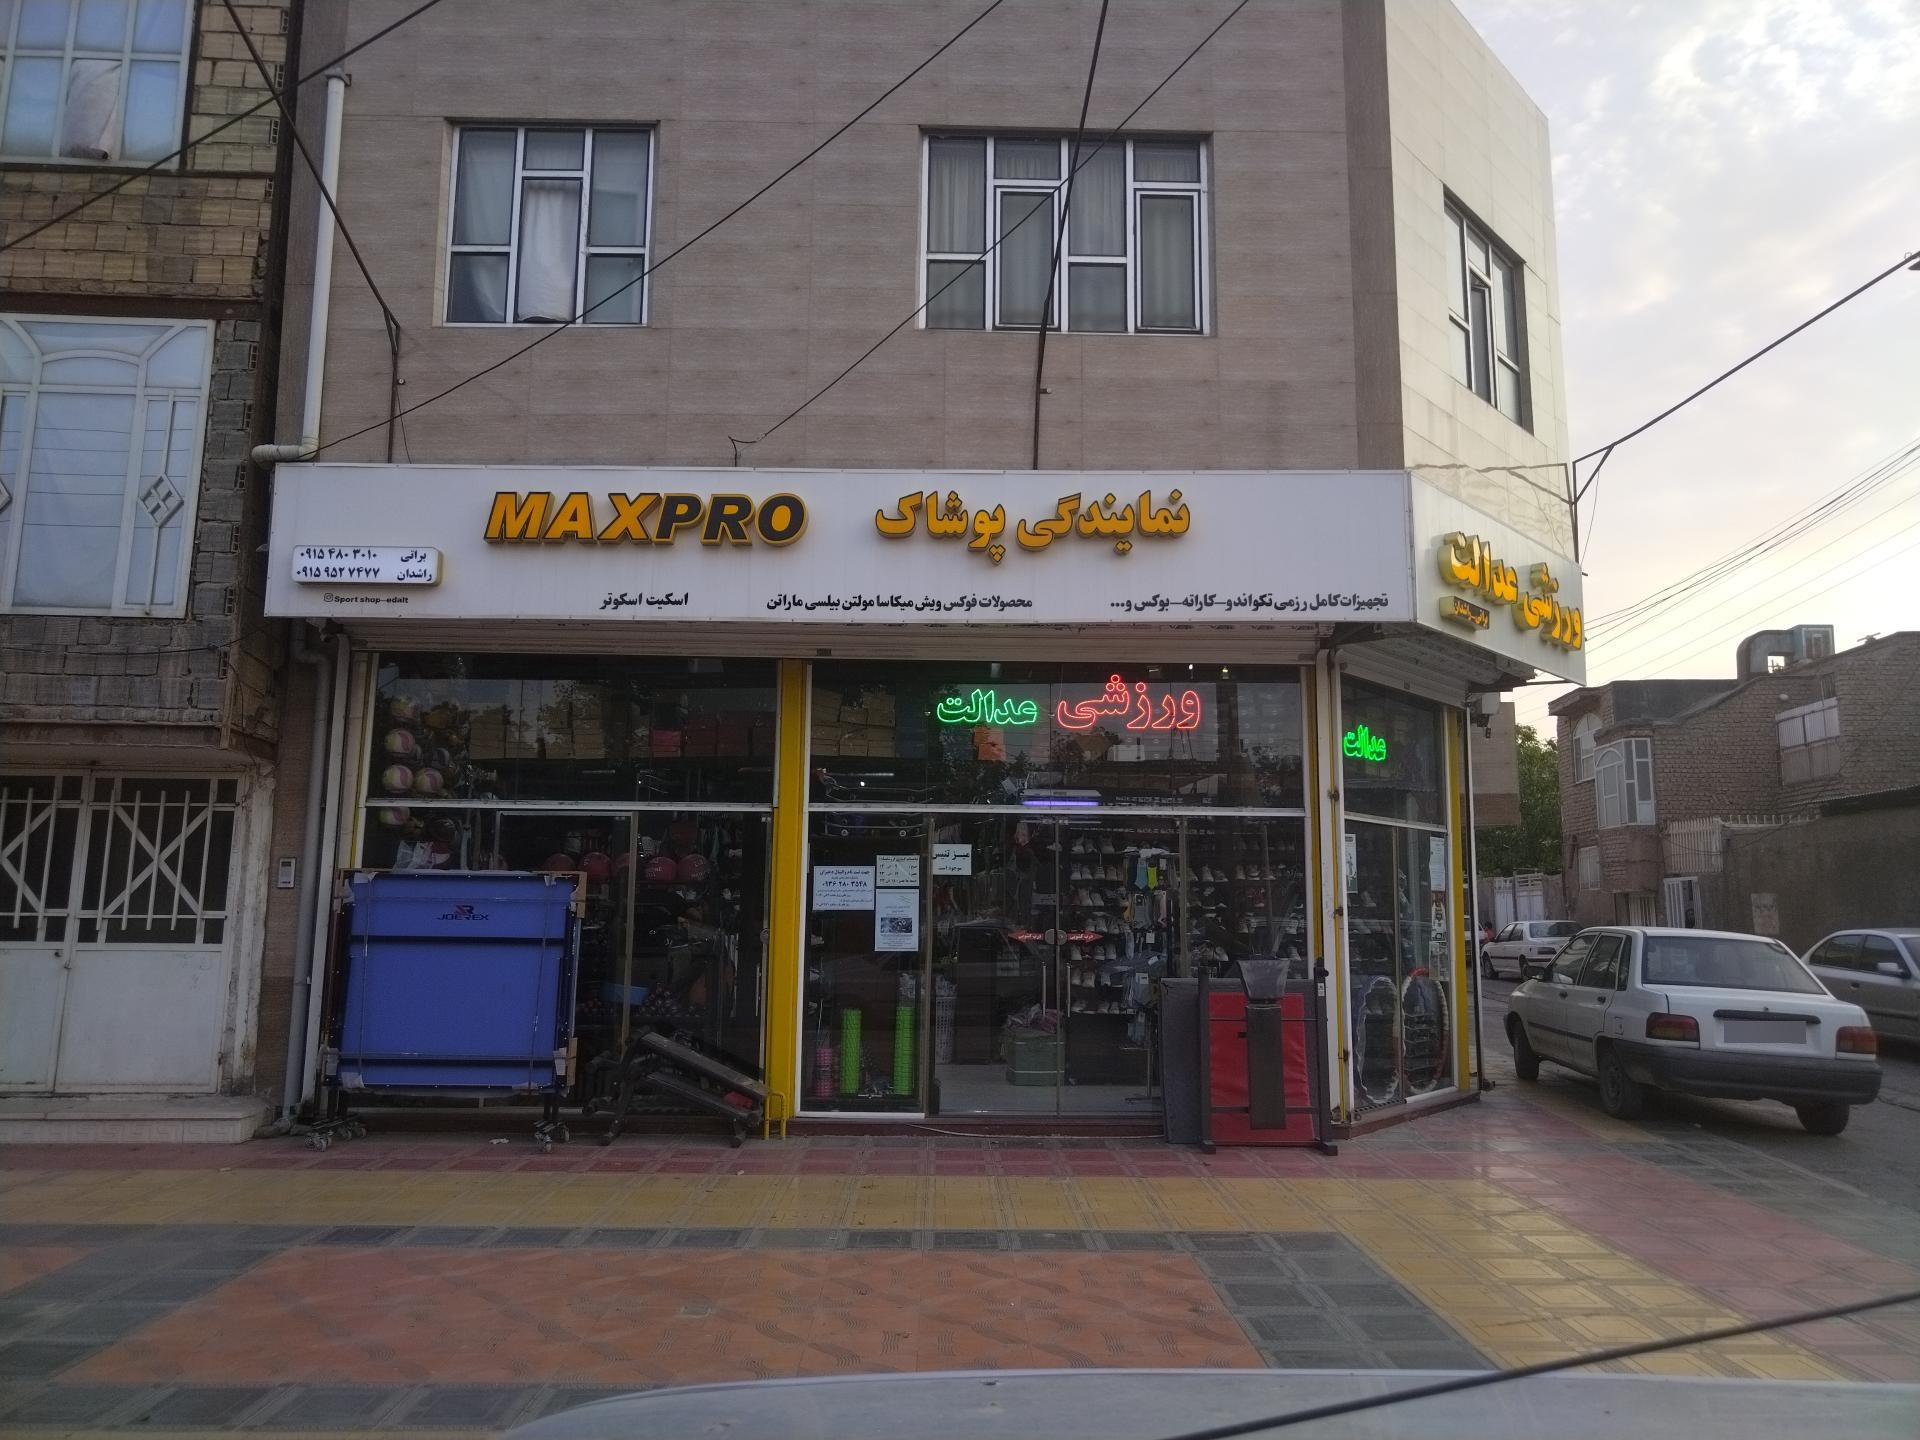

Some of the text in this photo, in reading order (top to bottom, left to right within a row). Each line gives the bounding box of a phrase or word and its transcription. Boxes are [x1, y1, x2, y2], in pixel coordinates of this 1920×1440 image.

[484, 492, 807, 546] MAXPRO
[875, 488, 1191, 563] نمایندگی پوشاک
[300, 548, 426, 562] براتی ۰۹۱۵ ۴۸۰ ۳۰۱۰
[296, 566, 432, 581] راشدان ۰۹۱۵ ۹۵۲ ۷۴۷۷
[1441, 531, 1582, 650] ورزشی عدالت
[334, 595, 358, 604] Sport
[599, 592, 689, 610] اسکیت اسکوتر
[766, 594, 804, 611] ماراتن
[841, 594, 875, 611] مولتن
[876, 594, 914, 611] میکاسا
[914, 596, 942, 611] ویش
[943, 593, 978, 611] فوکس
[979, 594, 1033, 611] محصولات
[1274, 596, 1308, 611] رزمی
[1309, 593, 1341, 611] کامل
[1340, 593, 1389, 611] تجهیزات
[937, 674, 1200, 728] ورزشی عدالت
[1343, 724, 1387, 762] عدالت
